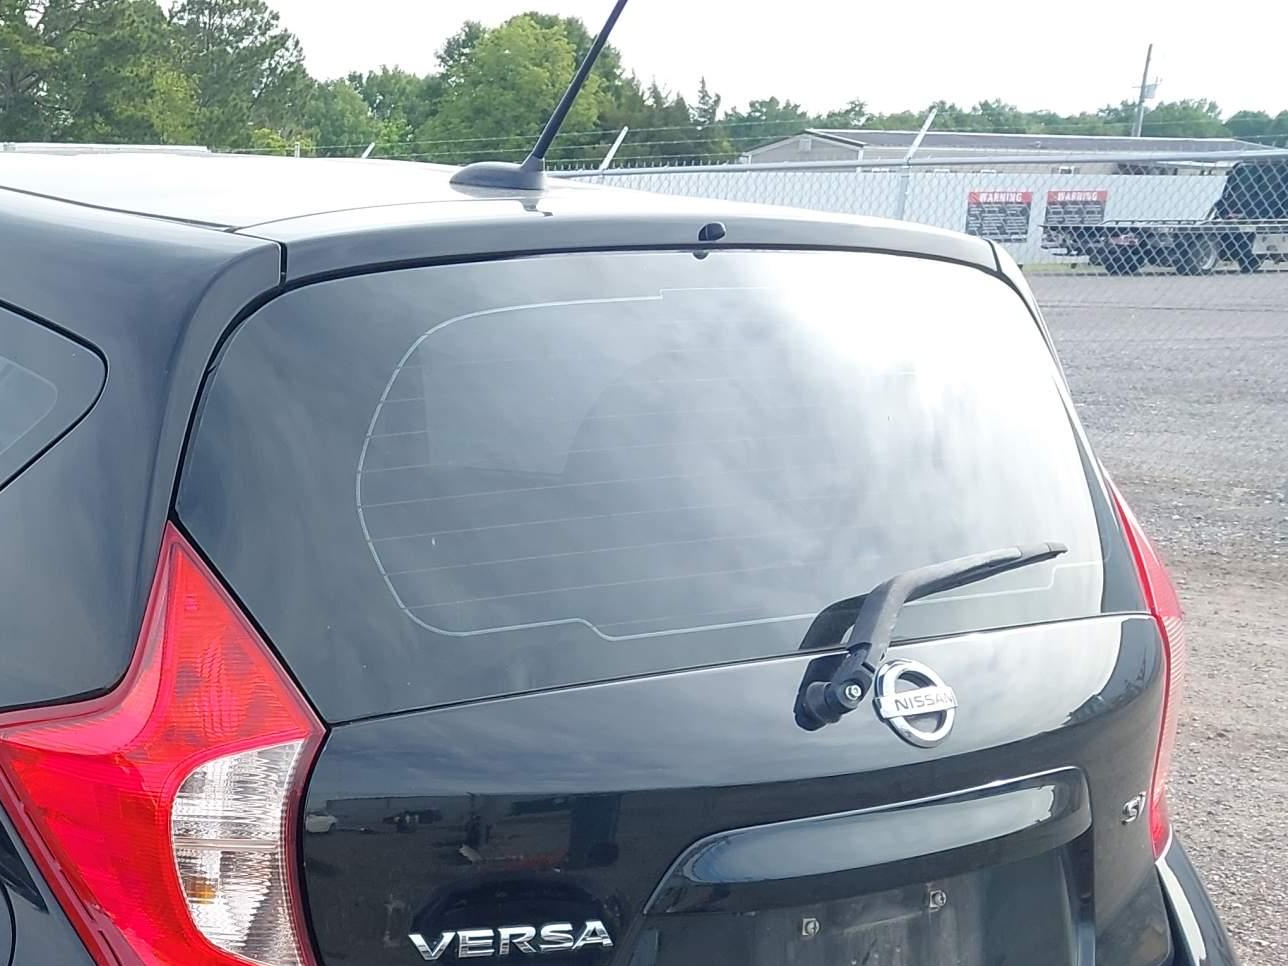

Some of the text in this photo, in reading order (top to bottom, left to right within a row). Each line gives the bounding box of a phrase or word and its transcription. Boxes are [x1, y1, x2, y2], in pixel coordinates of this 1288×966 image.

[979, 192, 1023, 202] WARNING
[1057, 191, 1098, 201] WARNING
[894, 692, 953, 711] NISSAN
[408, 920, 614, 961] VERSA
